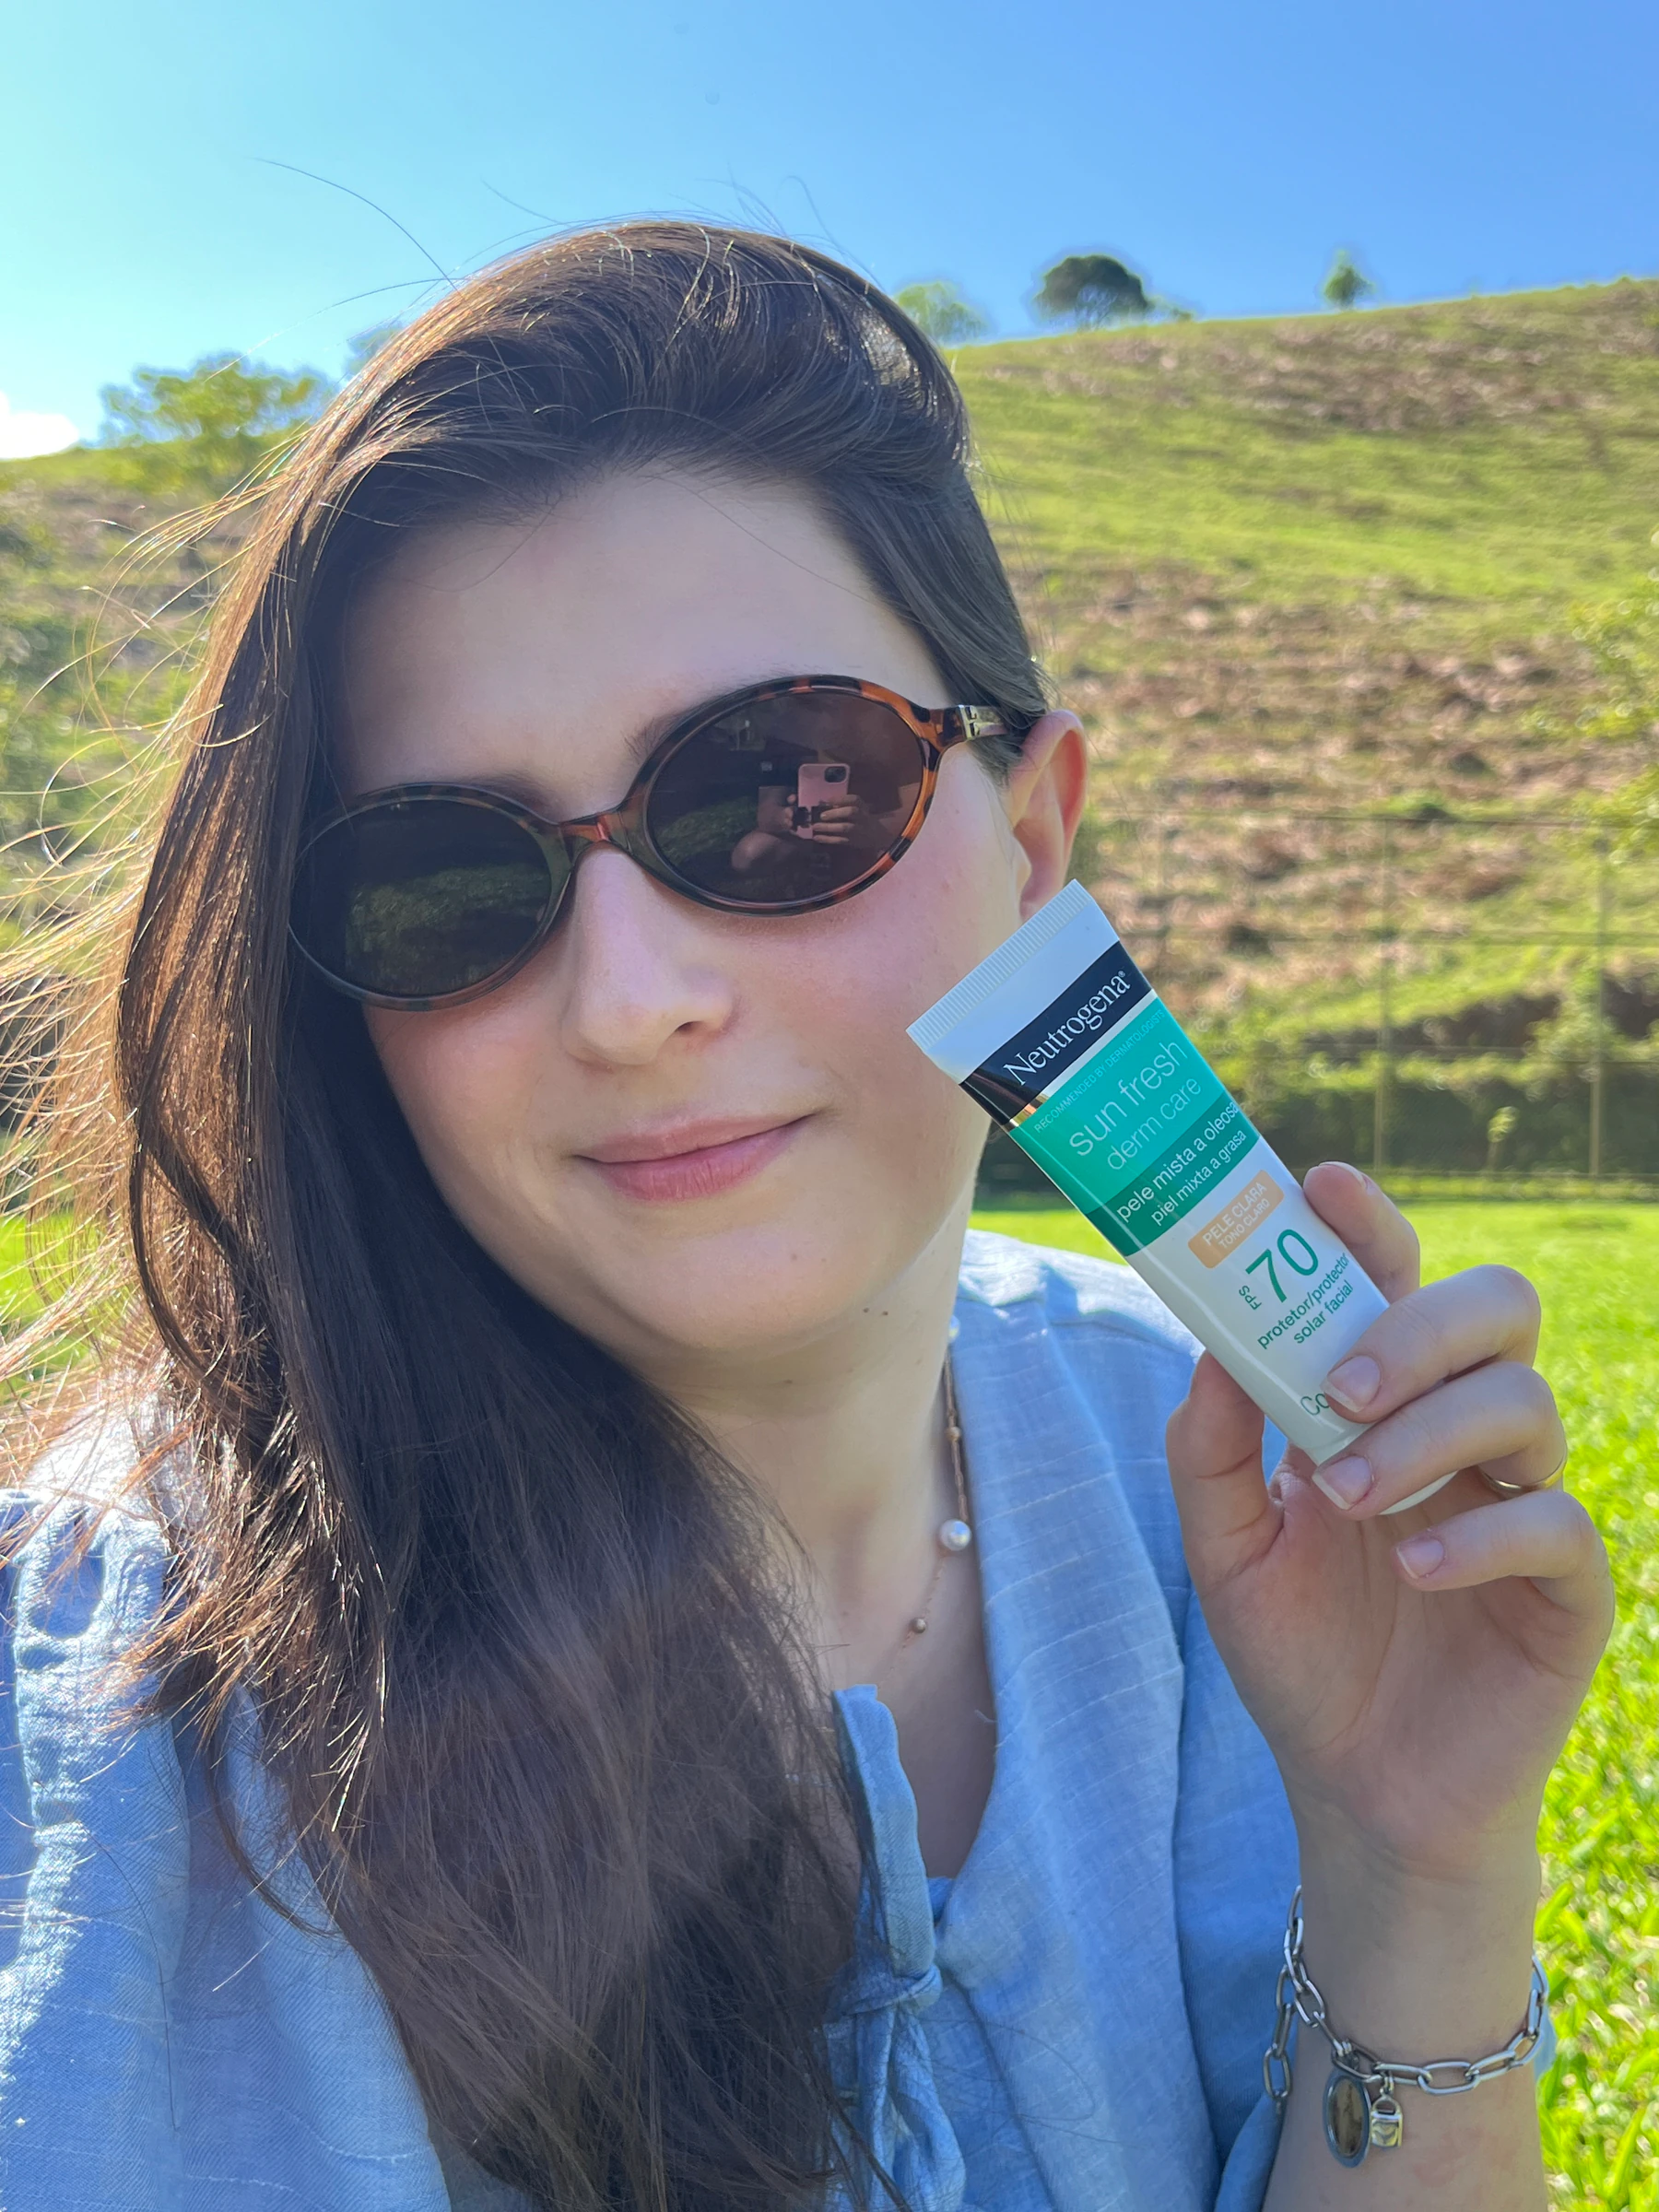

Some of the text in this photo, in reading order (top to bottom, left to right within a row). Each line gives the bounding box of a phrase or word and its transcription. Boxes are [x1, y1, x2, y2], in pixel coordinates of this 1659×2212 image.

[1034, 1009, 1167, 1134] RECOMMENDED BY DERMATOLOGISTS
[1069, 1040, 1188, 1156] sun fresh
[1107, 1077, 1202, 1171] derm care
[1116, 1101, 1239, 1223] pele mista a oleosa
[1151, 1129, 1247, 1227] piel mixta a grasa
[1202, 1182, 1267, 1247] PELE CLARA
[1218, 1198, 1271, 1250] TONO CLARO
[1238, 1229, 1319, 1311] FPS 70
[1257, 1252, 1350, 1350] protetor/protector
[1293, 1281, 1354, 1344] solar facial
[1300, 1392, 1330, 1416] Co
